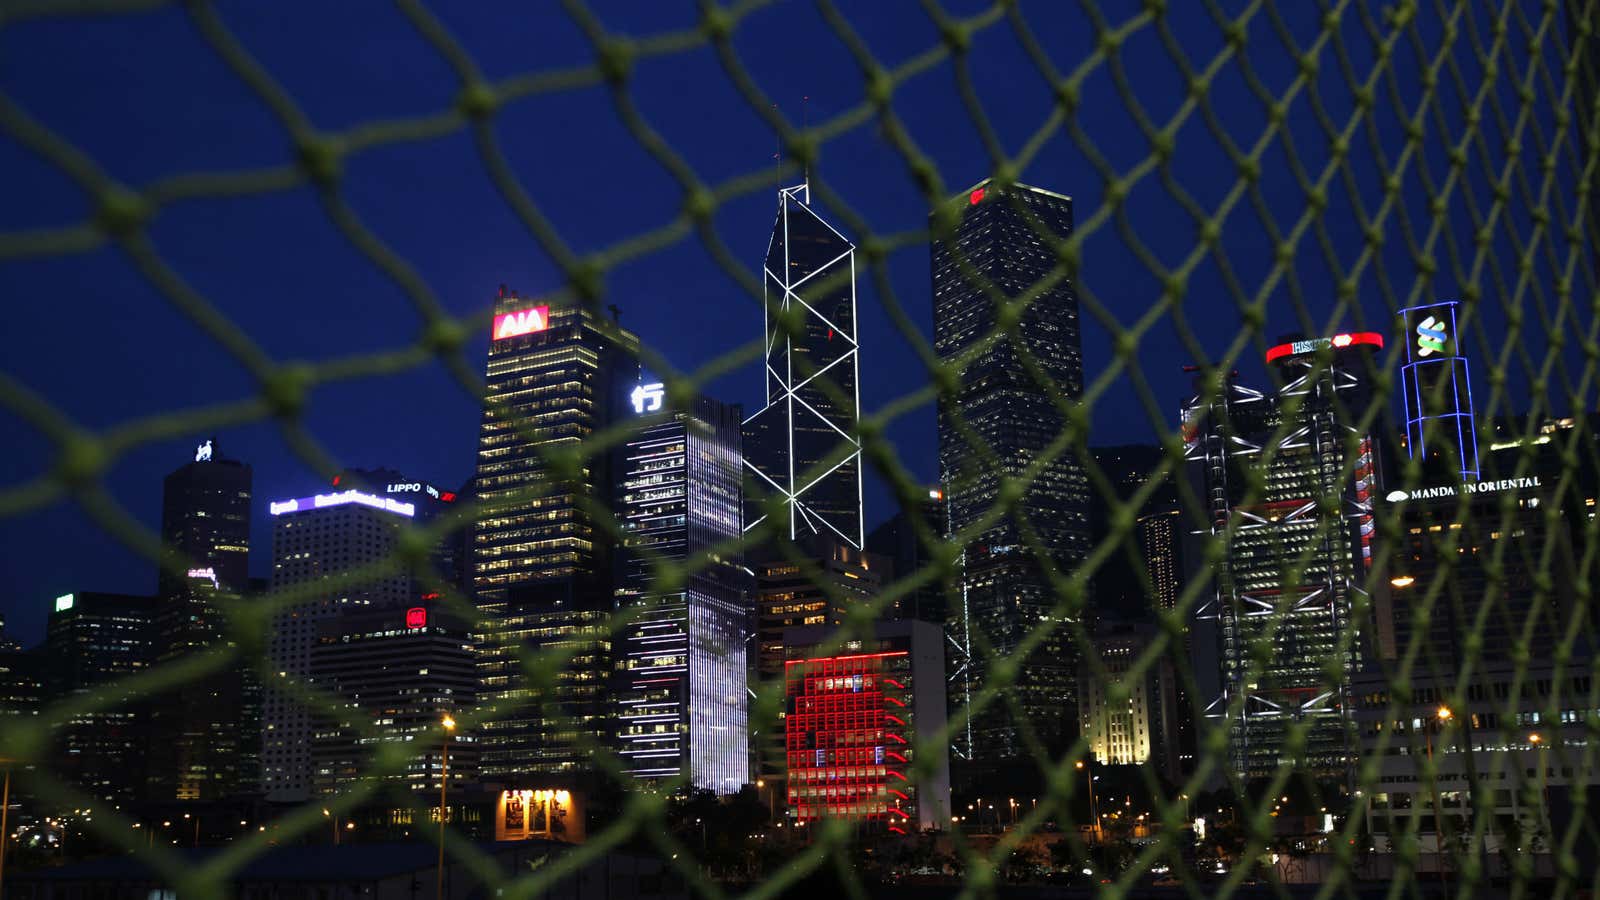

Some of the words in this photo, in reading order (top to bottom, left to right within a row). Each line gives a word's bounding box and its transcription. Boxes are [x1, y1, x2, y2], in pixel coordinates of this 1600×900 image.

[499, 309, 543, 338] AIA
[631, 383, 665, 413] 行
[387, 483, 421, 493] LIPPO
[1411, 484, 1476, 500] MANDAIN
[1478, 476, 1542, 493] ORIENTAL
